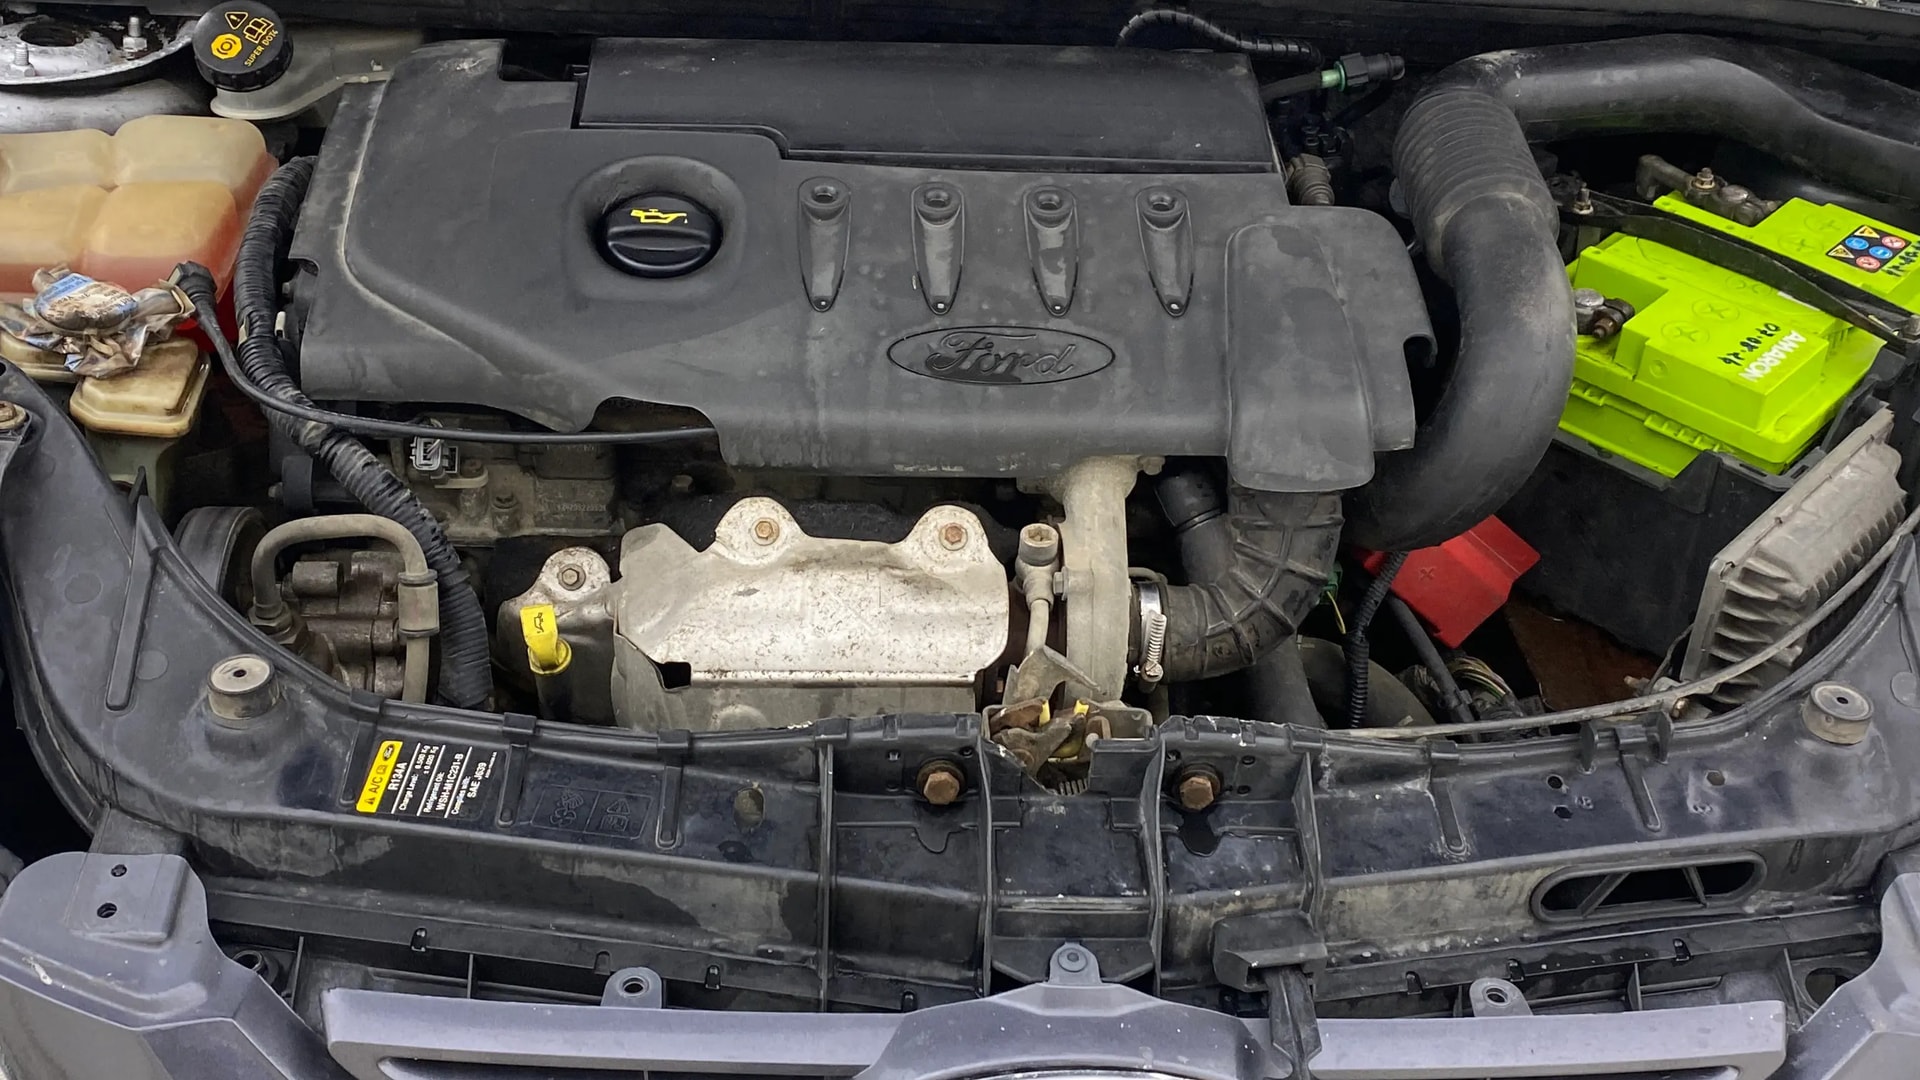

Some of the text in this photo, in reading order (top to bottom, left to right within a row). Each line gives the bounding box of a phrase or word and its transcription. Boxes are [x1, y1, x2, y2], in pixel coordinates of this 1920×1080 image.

[244, 45, 265, 67] SUPER
[925, 331, 1077, 375] Ford
[1738, 329, 1807, 383] AMARON
[369, 776, 383, 794] A/C
[388, 762, 408, 791] R134A
[435, 753, 464, 811] WSH-M1C231-B
[467, 762, 487, 798] SAE J639
[399, 790, 413, 811] Charge
[423, 782, 441, 813] Refrigerant
[451, 789, 467, 815] Complies
